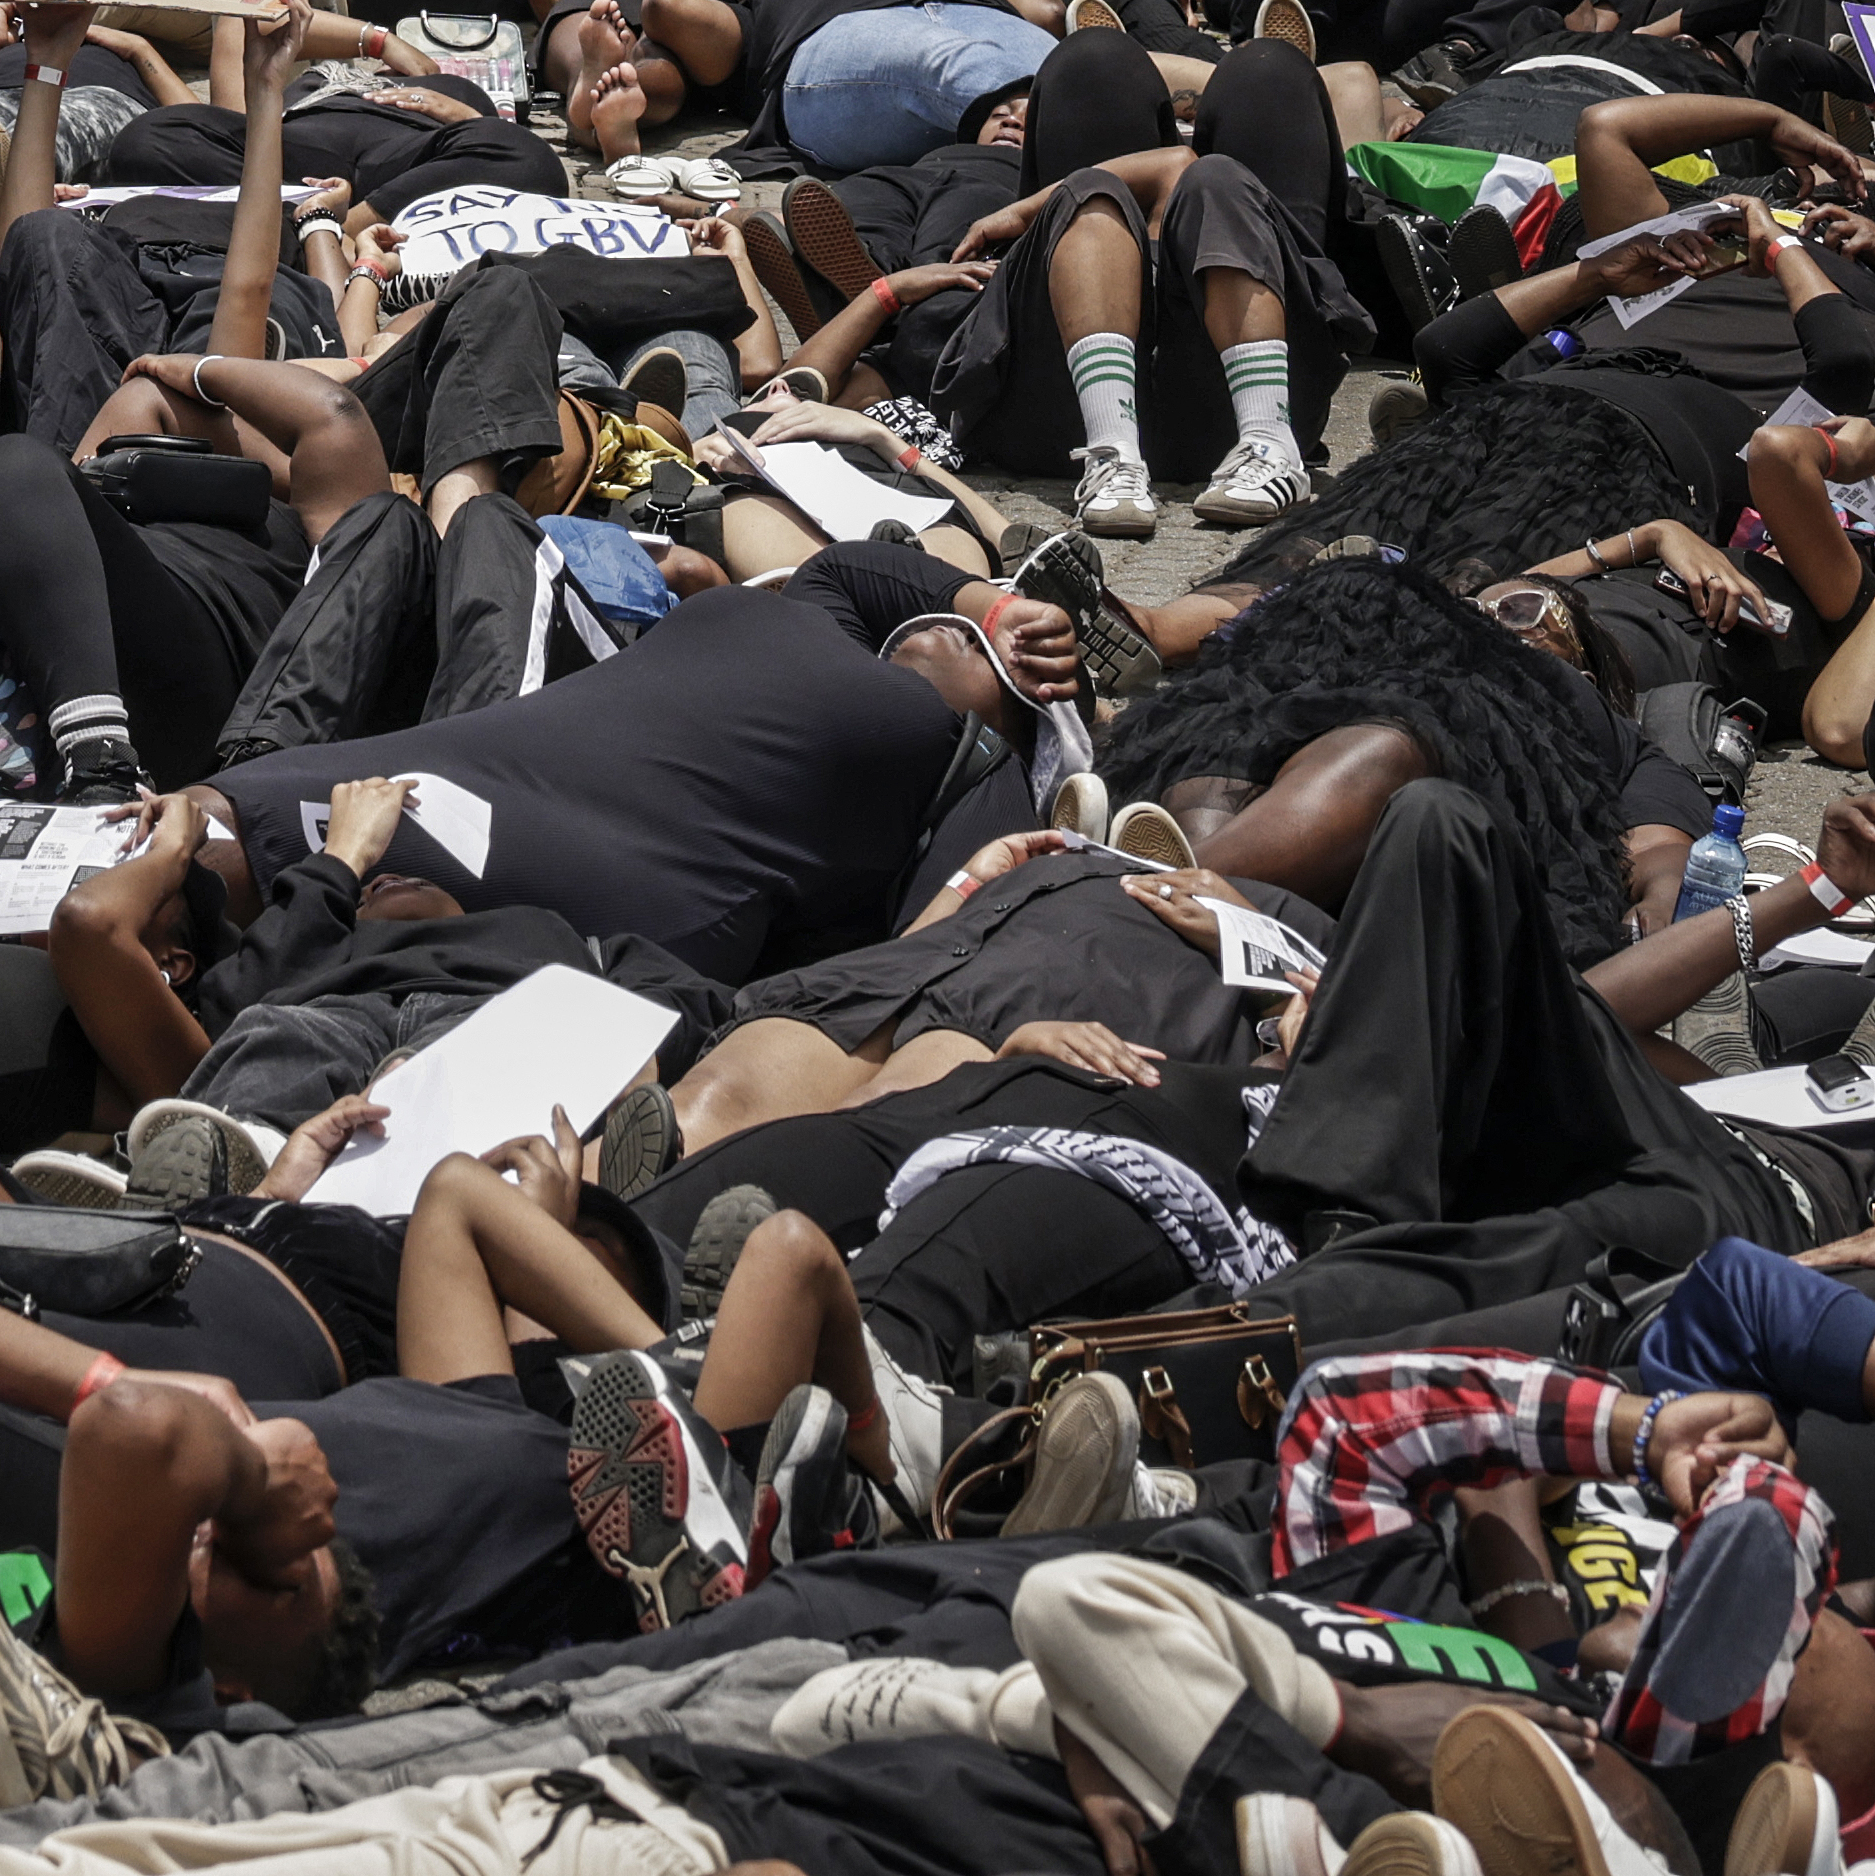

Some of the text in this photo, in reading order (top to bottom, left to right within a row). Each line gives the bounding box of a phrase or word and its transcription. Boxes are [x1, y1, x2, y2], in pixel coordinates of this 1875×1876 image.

[403, 189, 521, 227] SAY
[421, 217, 671, 262] TO GBV
